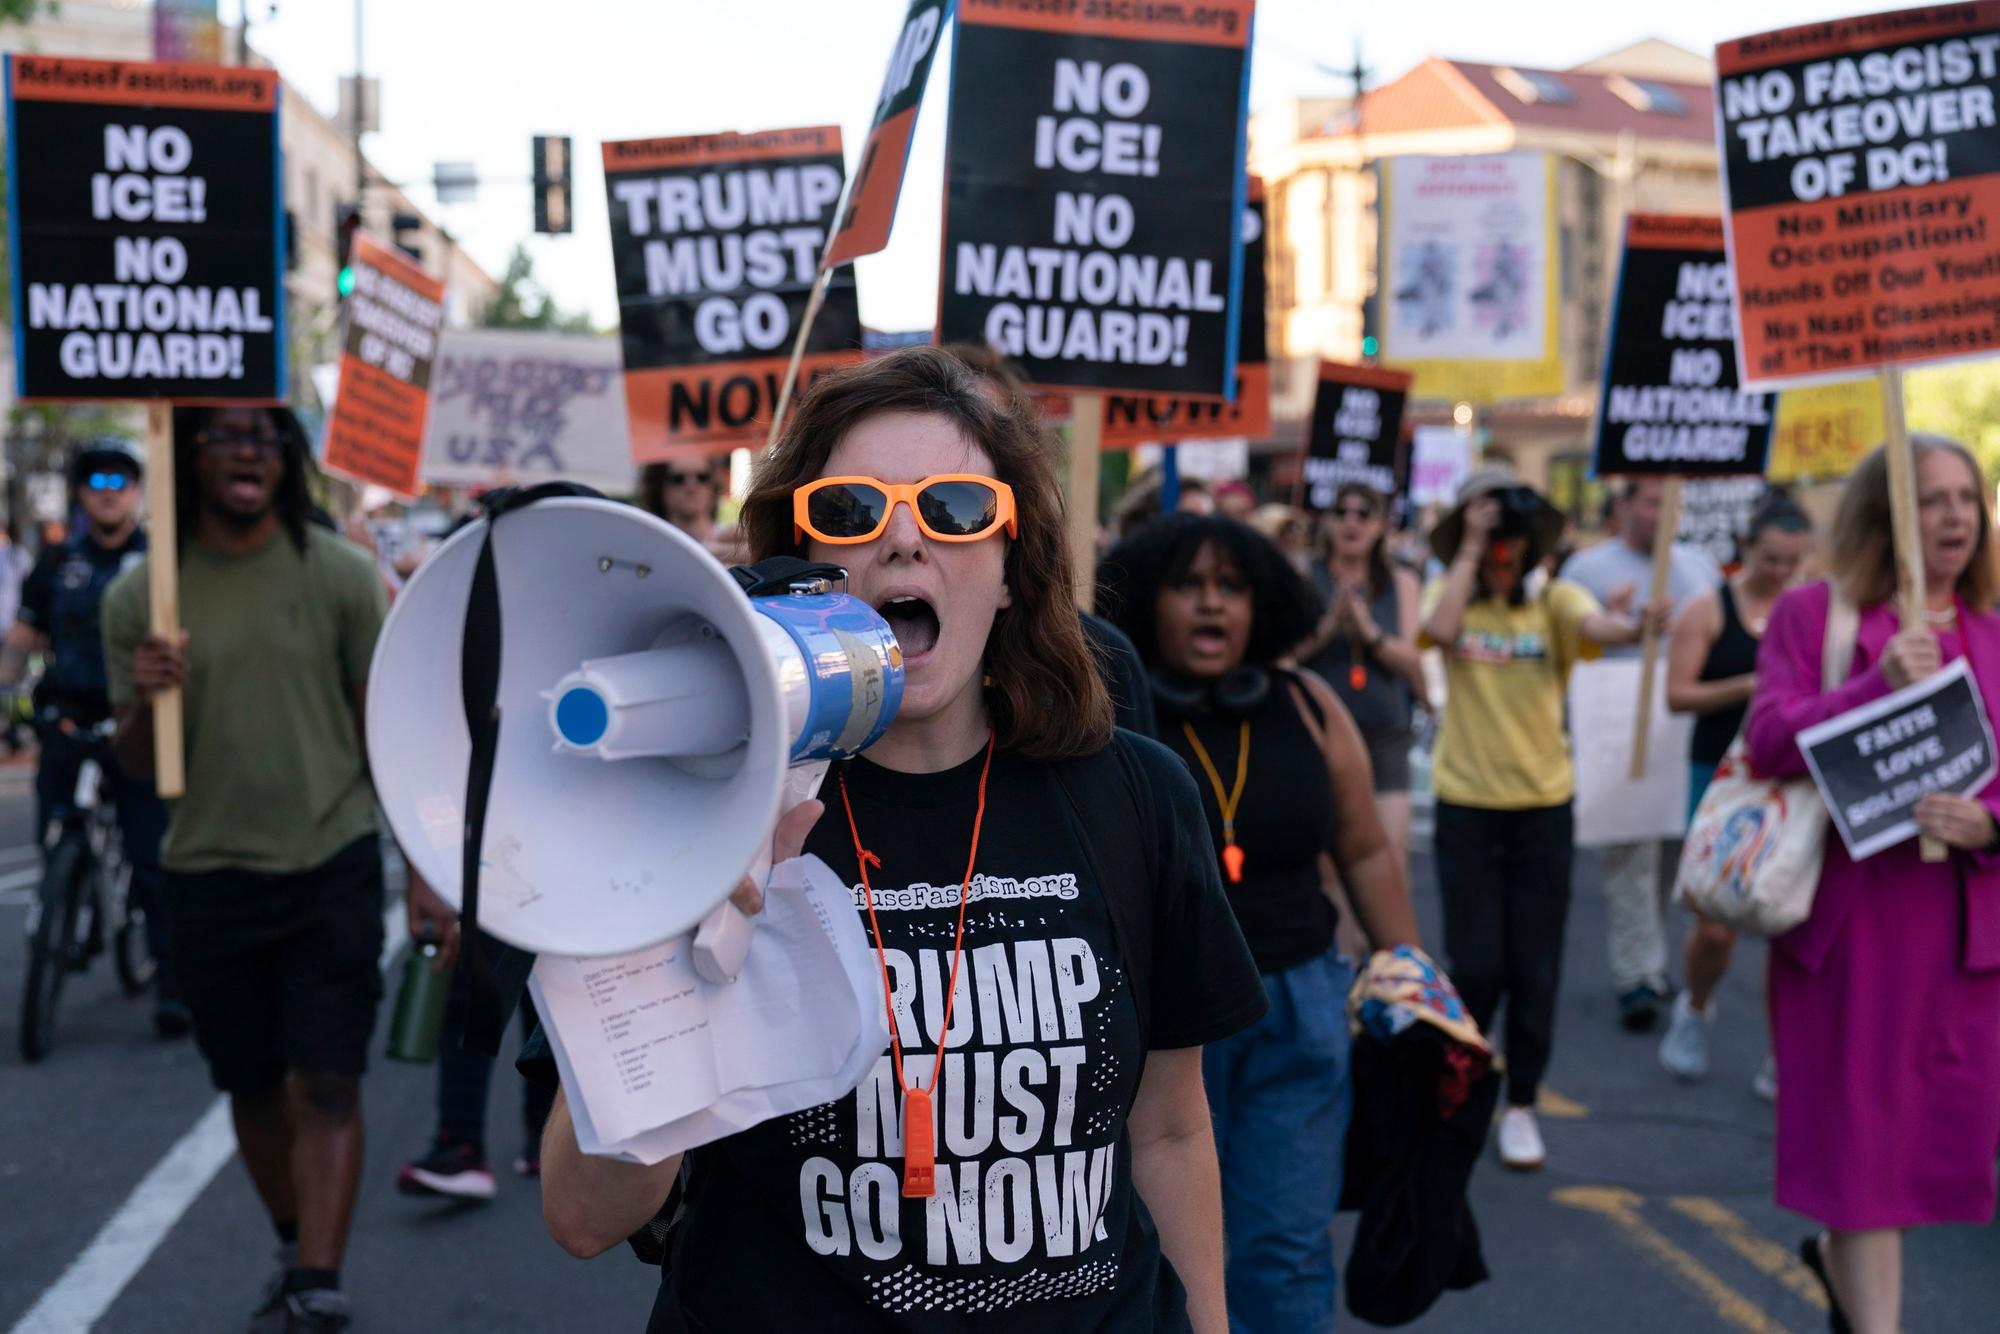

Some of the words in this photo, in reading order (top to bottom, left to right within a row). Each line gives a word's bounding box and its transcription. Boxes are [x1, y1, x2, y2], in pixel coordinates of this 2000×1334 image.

[972, 0, 1239, 34] useFascism.org
[19, 62, 264, 98] RefuseFascism.org
[1053, 58, 1150, 118] NO
[1723, 69, 1796, 121] NO
[1802, 34, 2000, 106] FASCIST
[103, 124, 192, 173] NO
[1034, 116, 1162, 178] ICE!
[1735, 86, 1996, 162] TAKEOVER
[1791, 152, 1856, 201] OF
[1865, 139, 1950, 191] DC!
[91, 173, 207, 222] ICE!
[612, 165, 842, 235] TRUMP
[1053, 192, 1135, 249] NO
[1777, 215, 1824, 237] No
[1837, 195, 1972, 228] Military
[113, 236, 188, 284] NO
[643, 227, 826, 296] MUST
[1768, 216, 1985, 270] Occupation!
[955, 243, 1224, 312] NATIONAL
[1676, 262, 1731, 301] NO
[1832, 271, 1870, 297] Off
[1879, 265, 1924, 291] Our
[28, 283, 273, 332] NATIONAL
[694, 292, 789, 354] GO
[1764, 320, 1798, 341] No
[1808, 307, 1864, 336] Nazi
[60, 331, 245, 379] GUARD!
[985, 302, 1190, 366] GUARD!
[1669, 348, 1722, 386] NO
[1608, 385, 1770, 425] NATIONAL
[447, 433, 564, 471] USA
[1621, 424, 1750, 462] GUARD!
[1854, 704, 1938, 757] FAITH
[1873, 735, 1944, 782] LOVE
[1846, 742, 1984, 828] SOLIDARITY
[852, 873, 1077, 908] fuseFascism.org
[870, 937, 1100, 1048] RUMP
[856, 1046, 1086, 1158] MUST
[800, 1157, 902, 1261] GO
[926, 1143, 1114, 1266] NOW!
